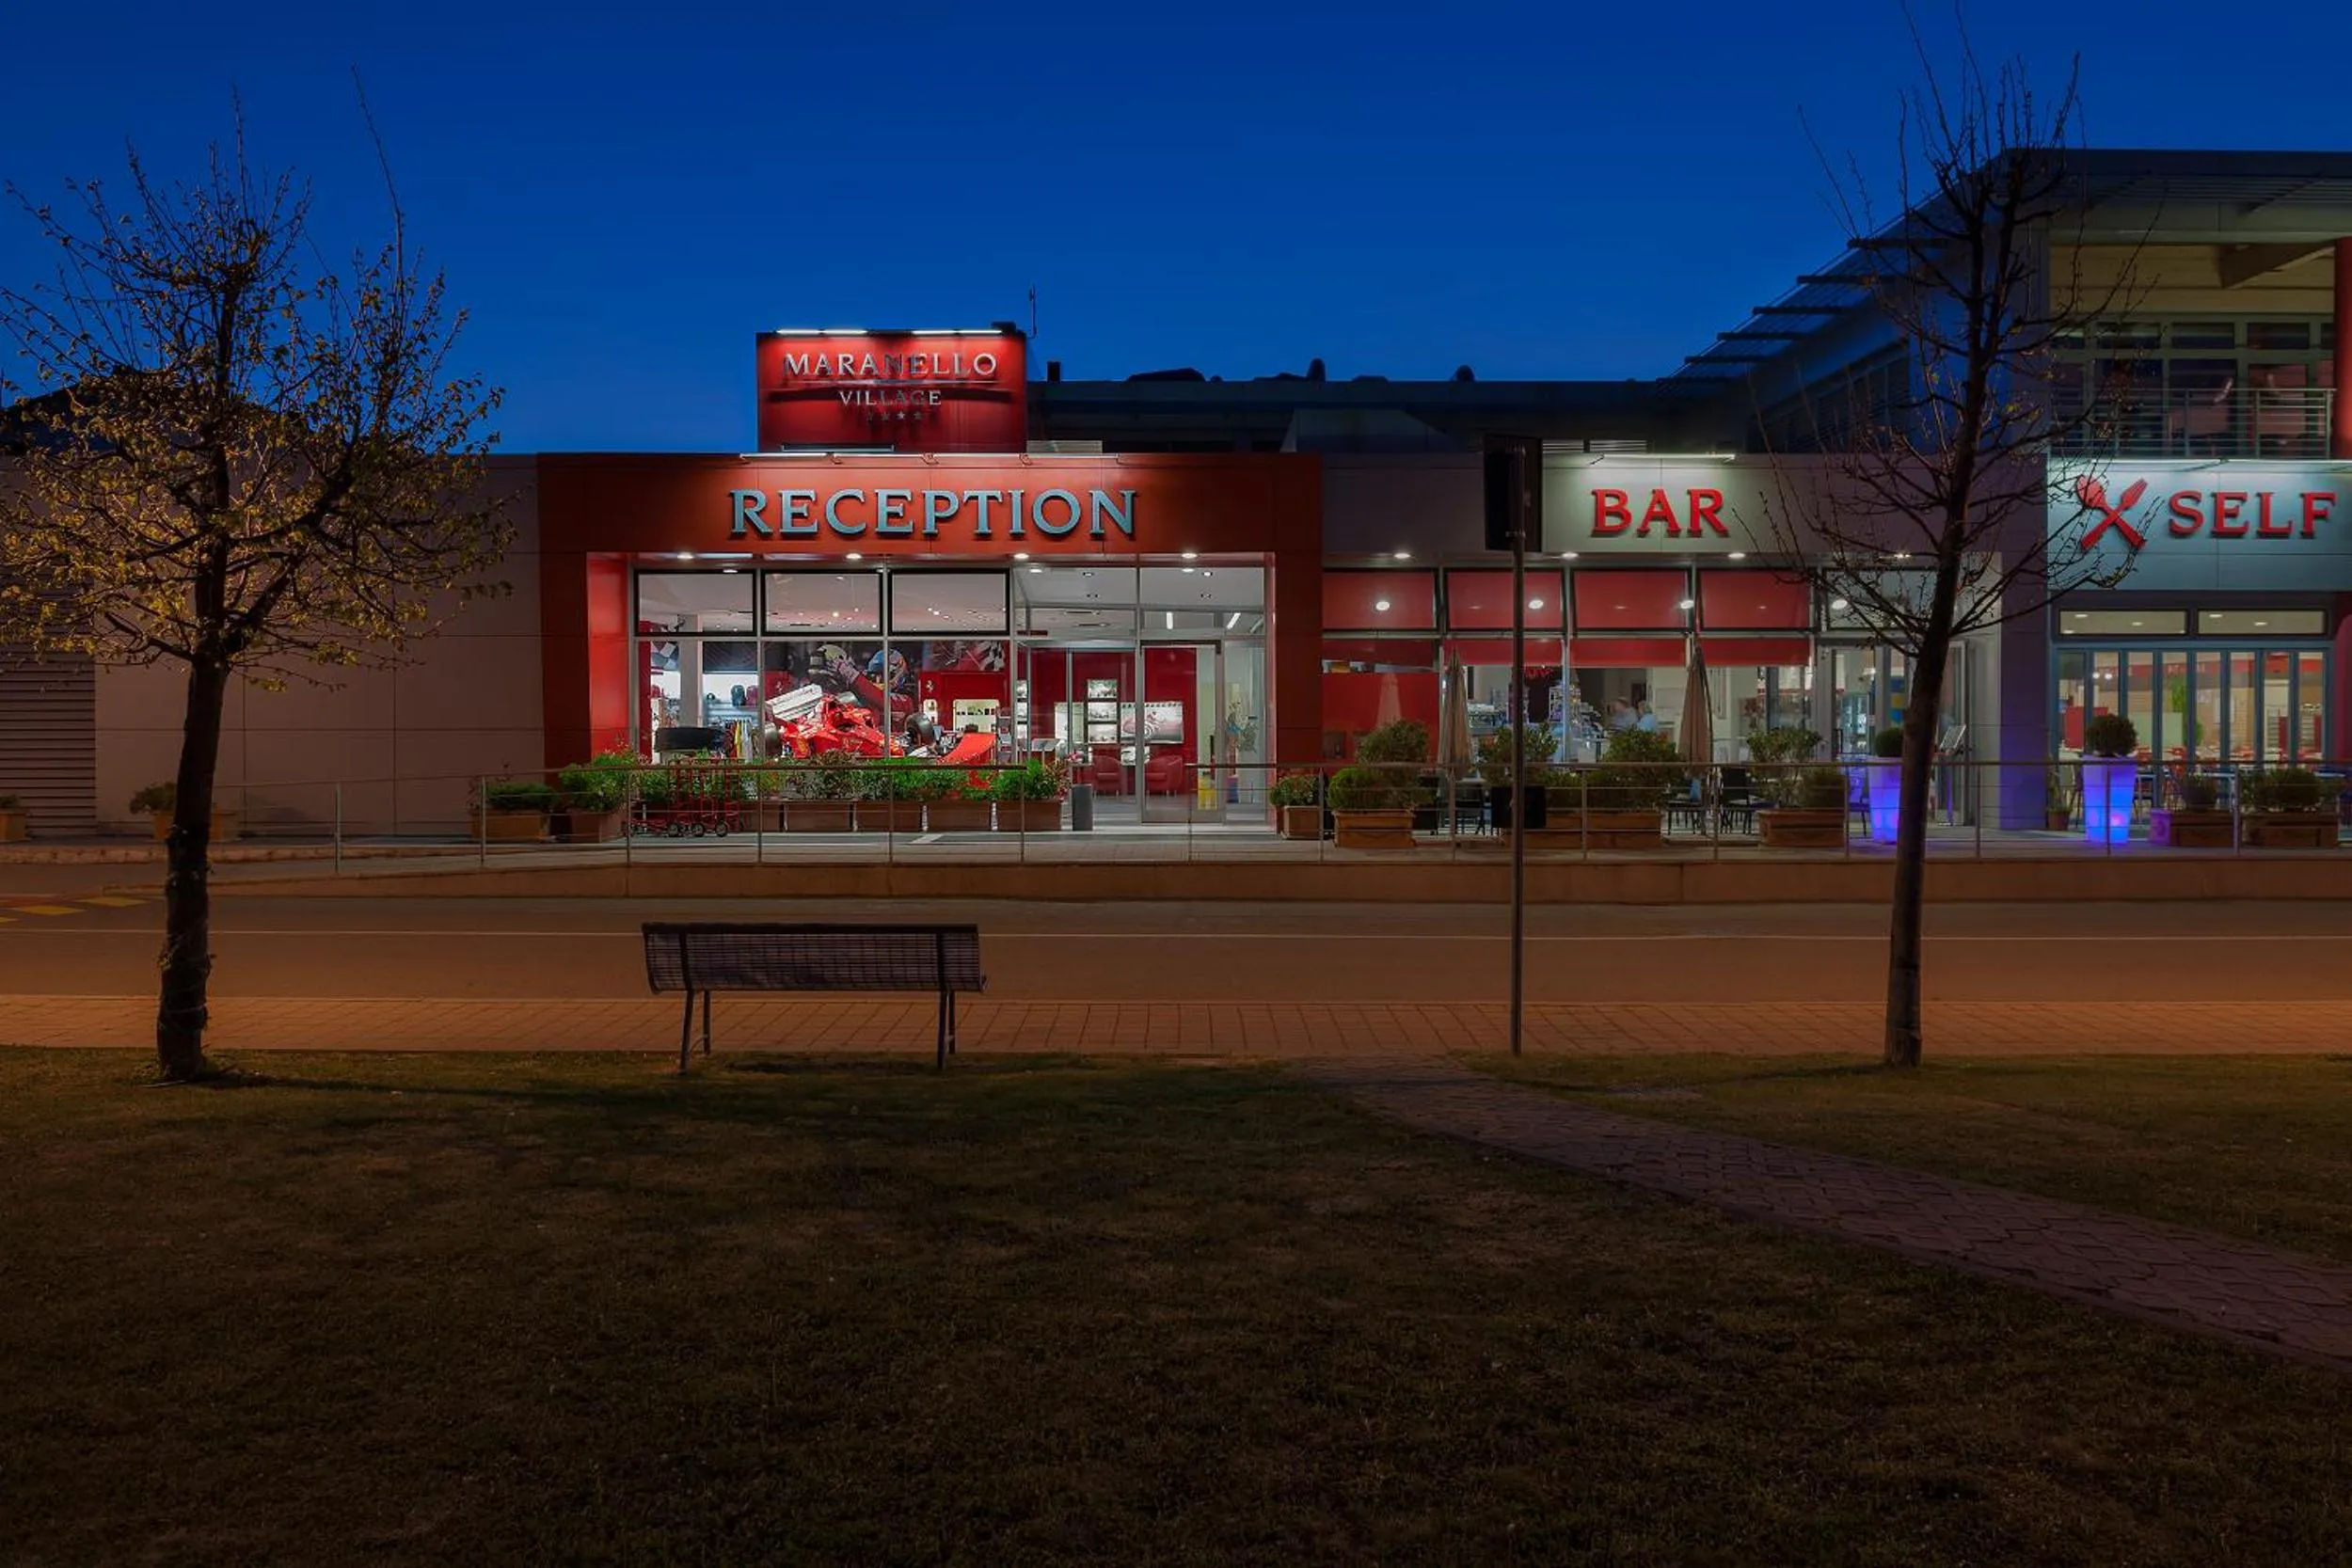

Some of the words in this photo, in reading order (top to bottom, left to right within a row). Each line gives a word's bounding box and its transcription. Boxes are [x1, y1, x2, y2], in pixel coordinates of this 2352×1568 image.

[784, 353, 997, 376] MARANELLO
[838, 389, 942, 406] VILLAGE
[729, 488, 1137, 535] RECEPTION
[1591, 488, 1729, 537] BAR
[2169, 490, 2337, 538] SELF
